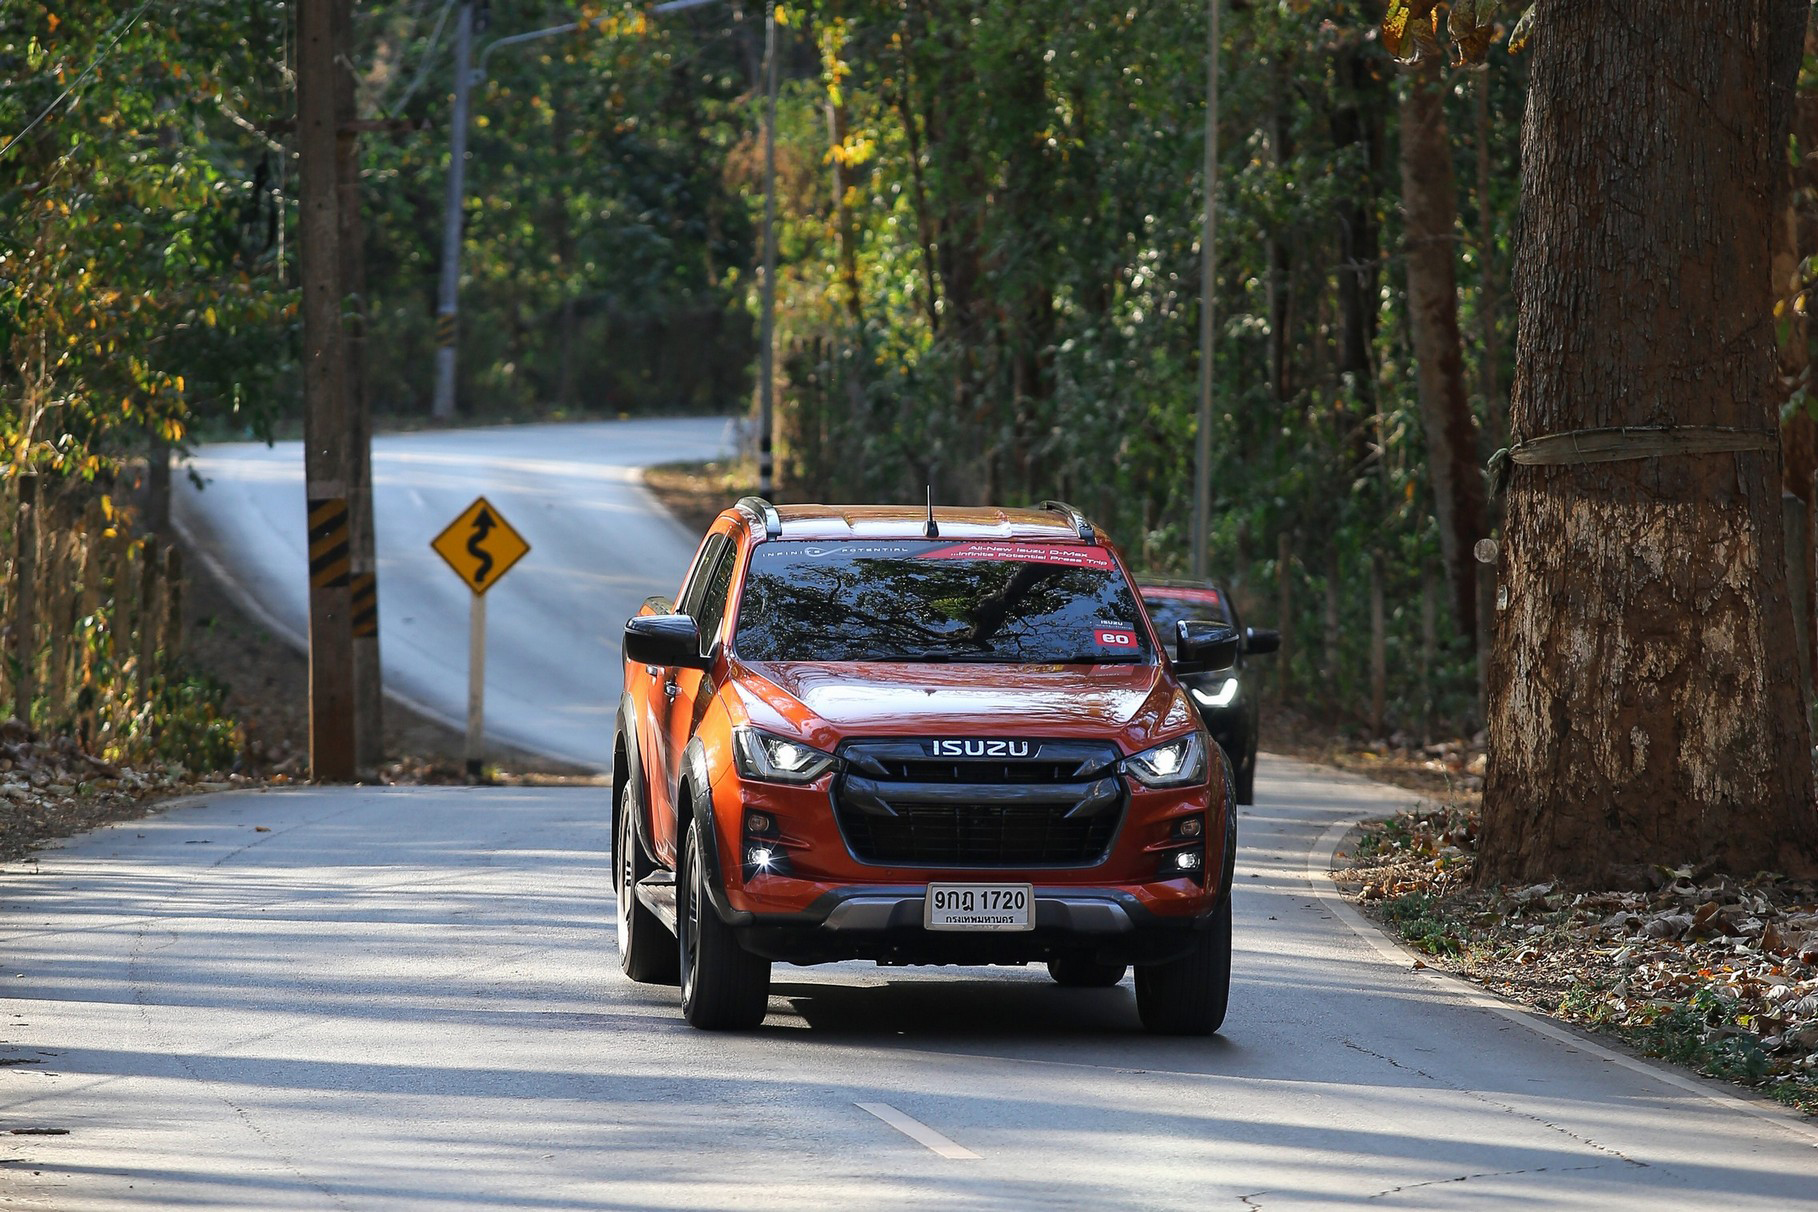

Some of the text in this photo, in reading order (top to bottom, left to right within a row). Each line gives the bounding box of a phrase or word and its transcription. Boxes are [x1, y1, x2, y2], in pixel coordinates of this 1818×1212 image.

[998, 552, 1047, 560] Potential
[1050, 555, 1082, 563] Press
[1086, 558, 1108, 566] Trip
[1049, 549, 1088, 558] D-Max
[933, 740, 1028, 756] ISUZU
[981, 891, 1025, 910] 1720
